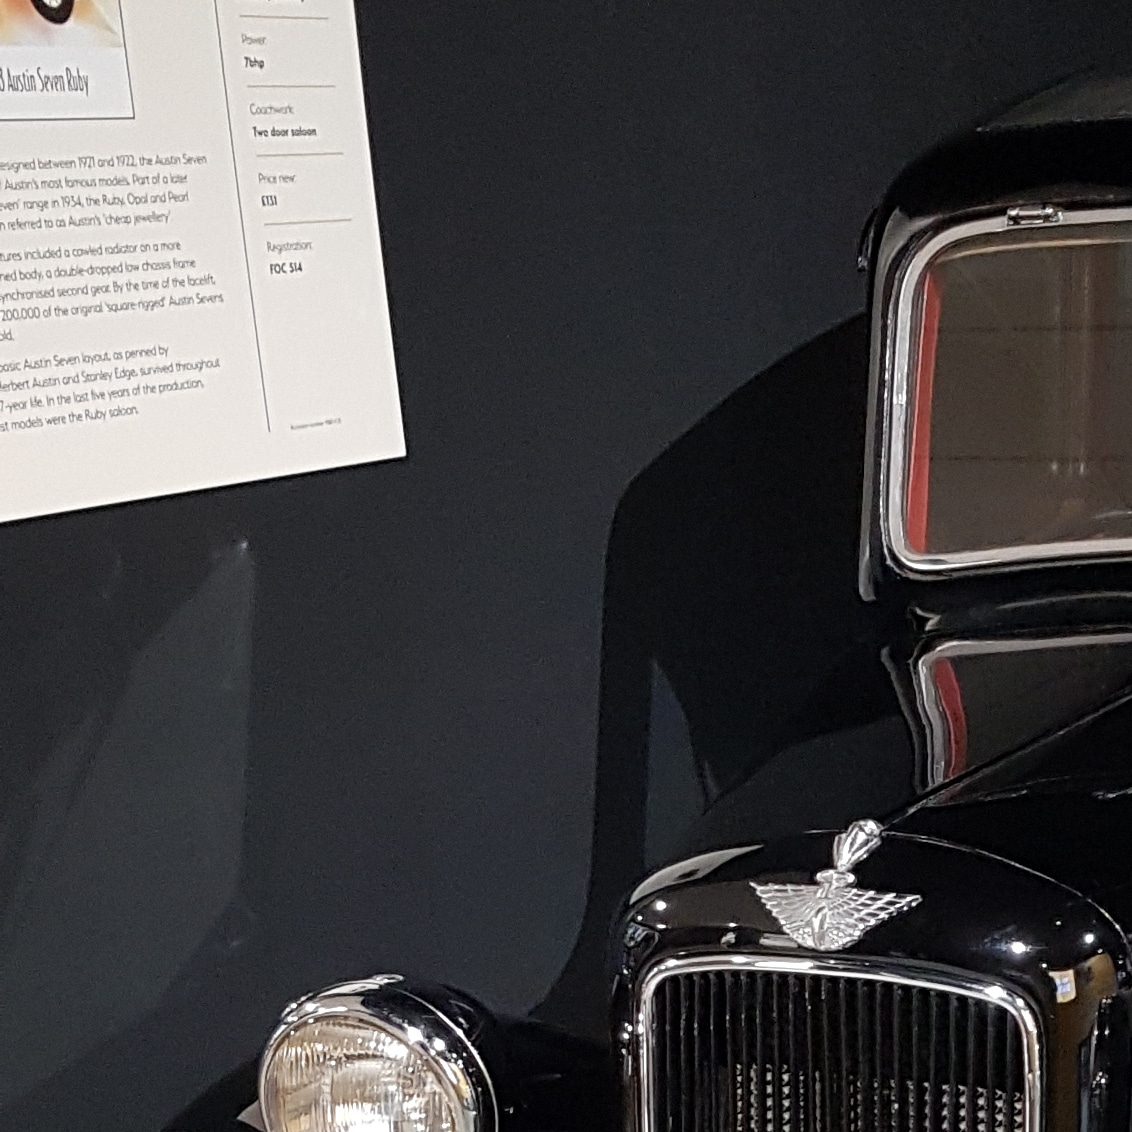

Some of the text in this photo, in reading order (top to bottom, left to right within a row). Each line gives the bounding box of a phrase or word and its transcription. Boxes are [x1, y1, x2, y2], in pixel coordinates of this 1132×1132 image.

[7, 66, 37, 92] Austin
[36, 66, 65, 92] Seven
[65, 66, 89, 97] Ruby
[249, 102, 295, 115] Coachwork
[252, 125, 317, 137] Two door saloon
[38, 158, 76, 169] between
[77, 155, 95, 169] 1921
[97, 156, 115, 168] and
[138, 154, 153, 166] the
[155, 154, 181, 166] Austin
[182, 153, 207, 165] Seven
[4, 178, 39, 190] Austin's
[40, 178, 63, 189] most
[64, 175, 97, 188] famous
[132, 173, 150, 186] Part
[151, 173, 161, 185] of
[162, 175, 169, 185] a
[23, 200, 49, 212] range
[51, 199, 60, 209] in
[85, 195, 100, 207] the
[126, 192, 149, 205] Opal
[150, 191, 167, 203] and
[167, 190, 189, 203] Pearl
[8, 217, 42, 231] referred
[43, 218, 54, 229] to
[55, 218, 66, 228] as
[68, 214, 102, 227] Austin's
[23, 246, 62, 260] included
[63, 248, 71, 258] a
[71, 244, 103, 258] cowled
[104, 243, 138, 255] radiator
[139, 243, 151, 253] on
[152, 243, 159, 252] a
[160, 241, 181, 251] more
[45, 268, 53, 279] a
[124, 261, 140, 273] low
[141, 259, 172, 272] chassis
[172, 257, 196, 269] frame
[269, 261, 303, 275] FOC 514
[56, 283, 89, 298] second
[112, 280, 124, 294] By
[125, 280, 140, 292] the
[141, 280, 160, 291] time
[161, 276, 171, 289] of
[171, 277, 186, 288] the
[42, 304, 52, 318] of
[53, 304, 69, 317] the
[70, 300, 103, 317] original
[168, 294, 195, 306] Austin
[195, 291, 224, 304] Sevens
[23, 357, 52, 370] Austin
[53, 353, 81, 368] Seven
[112, 350, 124, 361] as
[124, 345, 157, 361] penned
[157, 344, 169, 358] by
[32, 376, 61, 389] Austin
[61, 371, 80, 386] and
[81, 368, 113, 383] Stanley
[139, 361, 174, 377] survived
[174, 357, 221, 373] throughout
[46, 394, 55, 407] In
[56, 393, 72, 406] the
[72, 391, 89, 404] last
[90, 387, 106, 401] five
[107, 387, 131, 401] years
[131, 383, 141, 397] of
[142, 383, 157, 395] the
[10, 416, 44, 430] models
[45, 414, 67, 426] were
[68, 411, 84, 423] the
[84, 407, 107, 421] Ruby
